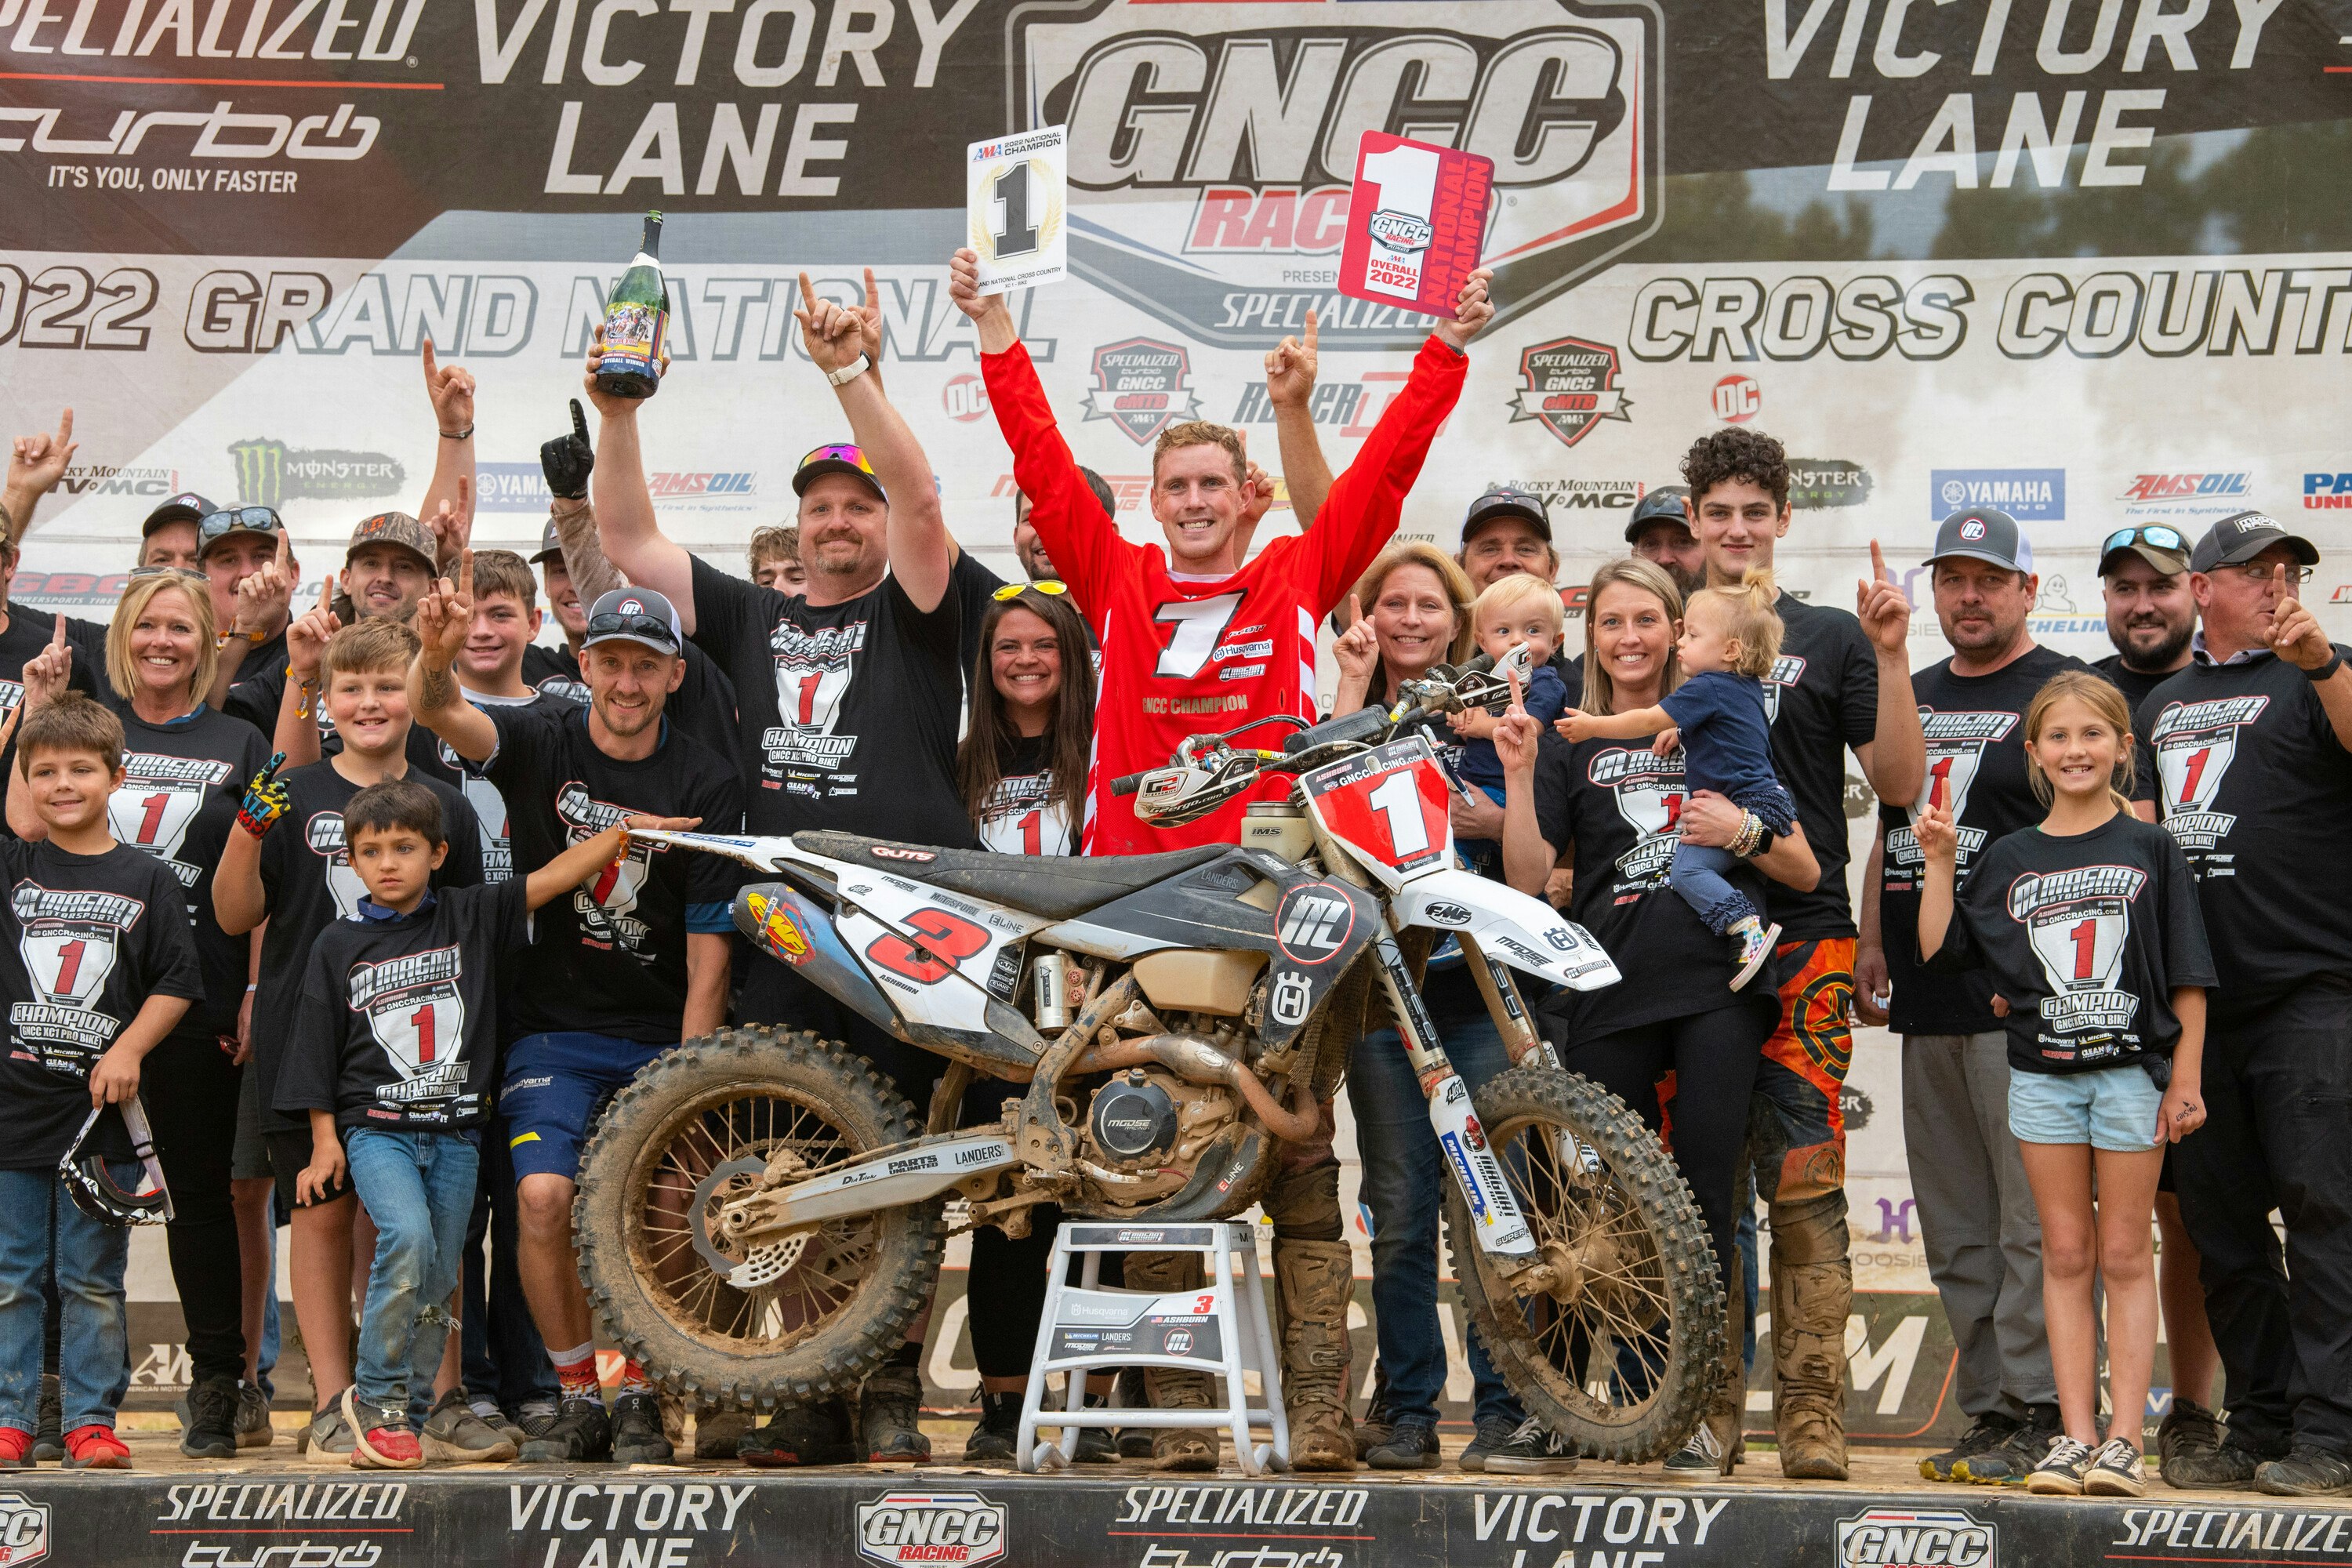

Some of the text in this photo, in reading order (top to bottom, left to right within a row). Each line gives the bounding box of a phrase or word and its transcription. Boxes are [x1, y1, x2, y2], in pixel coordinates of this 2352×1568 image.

[474, 0, 978, 88] VICTORY
[1766, 0, 2278, 79] VICTORY
[1065, 33, 1617, 187] GNCC
[544, 102, 858, 196] LANE
[1004, 138, 1062, 156] CHAMPION
[1005, 132, 1061, 147] 2022 NATIONAL
[1827, 89, 2167, 191] LANE
[972, 143, 1004, 160] AMA
[48, 165, 299, 192] IT'S YOU, ONLY FASTER
[994, 160, 1039, 260] 1
[1362, 144, 1440, 301] 1
[1374, 216, 1429, 241] GNCC
[1385, 234, 1415, 245] RACING
[1425, 157, 1468, 308] NATIONAL
[990, 266, 1062, 285] NATIONAL CROSS COUNTRY
[1371, 259, 1419, 277] OVERALL
[1369, 269, 1417, 290] 2022
[185, 270, 539, 358] GRAND
[1628, 274, 1975, 363] CROSS
[625, 358, 645, 368] WINNER
[1102, 355, 1178, 366] SPECIALIZED
[1531, 354, 1609, 367] SPECIALIZED
[1116, 376, 1166, 390] GNCC
[1544, 376, 1595, 391] GNCC
[1114, 394, 1169, 410] eMTB
[1542, 394, 1599, 411] eMTB
[1715, 377, 1760, 419] DC
[1128, 415, 1155, 423] AMA
[1556, 415, 1584, 424] AMA
[89, 466, 169, 477] MOUNTAIN
[286, 460, 394, 479] MONSTER
[649, 472, 757, 497] AMSOIL
[1508, 480, 1635, 492] ROCKY MOUNTAIN
[1968, 481, 2053, 503] YAMAHA
[2125, 473, 2246, 500] AMSOIL
[9, 596, 83, 604] POWERSPORTS
[1226, 642, 1271, 656] Husqvarna
[799, 671, 823, 724] 1
[1143, 695, 1248, 714] GNCC CHAMPION
[2173, 715, 2241, 731] MOTORSPORTS
[764, 728, 855, 755] CHAMPION
[2172, 735, 2230, 749] GNCCRACING.COM
[771, 750, 838, 768] GNCC PRO BIKE
[127, 769, 208, 780] MOTORSPORTS
[1316, 763, 1352, 783] ASHBURN
[2180, 747, 2211, 804] 1
[126, 784, 196, 793] GNCCRACING.COM
[1149, 792, 1222, 814] G2ergo.com
[136, 793, 171, 845] 1
[1369, 768, 1429, 858] 1
[1017, 810, 1041, 856] 1
[1251, 826, 1282, 837] IMS
[2181, 833, 2213, 847] PRO BIKE
[870, 845, 936, 862] GUTS
[1410, 855, 1433, 868] Husqvarna
[1899, 849, 1917, 859] GNCC
[1200, 869, 1239, 889] LANDERS
[2039, 887, 2125, 906] MOTORSPORTS
[36, 909, 119, 923] MOTORSPORTS
[1425, 903, 1472, 922] FMF
[2038, 906, 2071, 919] ASHBURN
[2049, 909, 2119, 924] GNCCRACING.COM
[42, 929, 110, 942] GNCCRACING.COM
[865, 906, 993, 986] 3
[1495, 935, 1554, 965] MOOSE
[2071, 919, 2096, 980] 1
[53, 939, 87, 995] 1
[376, 971, 452, 994] MOTORSPORTS
[879, 973, 920, 996] ASHBURN
[376, 992, 408, 1007] ASHBURN
[387, 991, 452, 1011] GNCCRACING.COM
[2043, 992, 2139, 1018] CHAMPION
[13, 1004, 118, 1036] CHAMPION
[2089, 1014, 2127, 1026] PRO BIKE
[22, 1025, 100, 1046] GNCC XC1 PRO BIKE
[411, 1004, 435, 1065] 1
[2045, 1035, 2076, 1045] Husqvarna
[1107, 1119, 1152, 1128] MOOSE
[887, 1154, 938, 1171] PARTS
[955, 1144, 1002, 1165] LANDERS
[889, 1162, 938, 1175] UNLIMITED
[1446, 1138, 1481, 1206] MICHELIN
[1495, 1229, 1525, 1247] SUPER
[1082, 1307, 1129, 1316] Husqvarna
[1193, 1295, 1214, 1314] 3
[158, 1484, 407, 1519] SPECIALIZED
[510, 1485, 756, 1530] VICTORY
[1116, 1487, 1369, 1526] SPECIALIZED
[866, 1509, 1000, 1546] GNCC
[1474, 1494, 1730, 1545] VICTORY
[181, 1540, 383, 1568] turbo
[547, 1538, 688, 1568] LANE
[1846, 1526, 1990, 1564] GNCC
[898, 1548, 969, 1562] RACING
